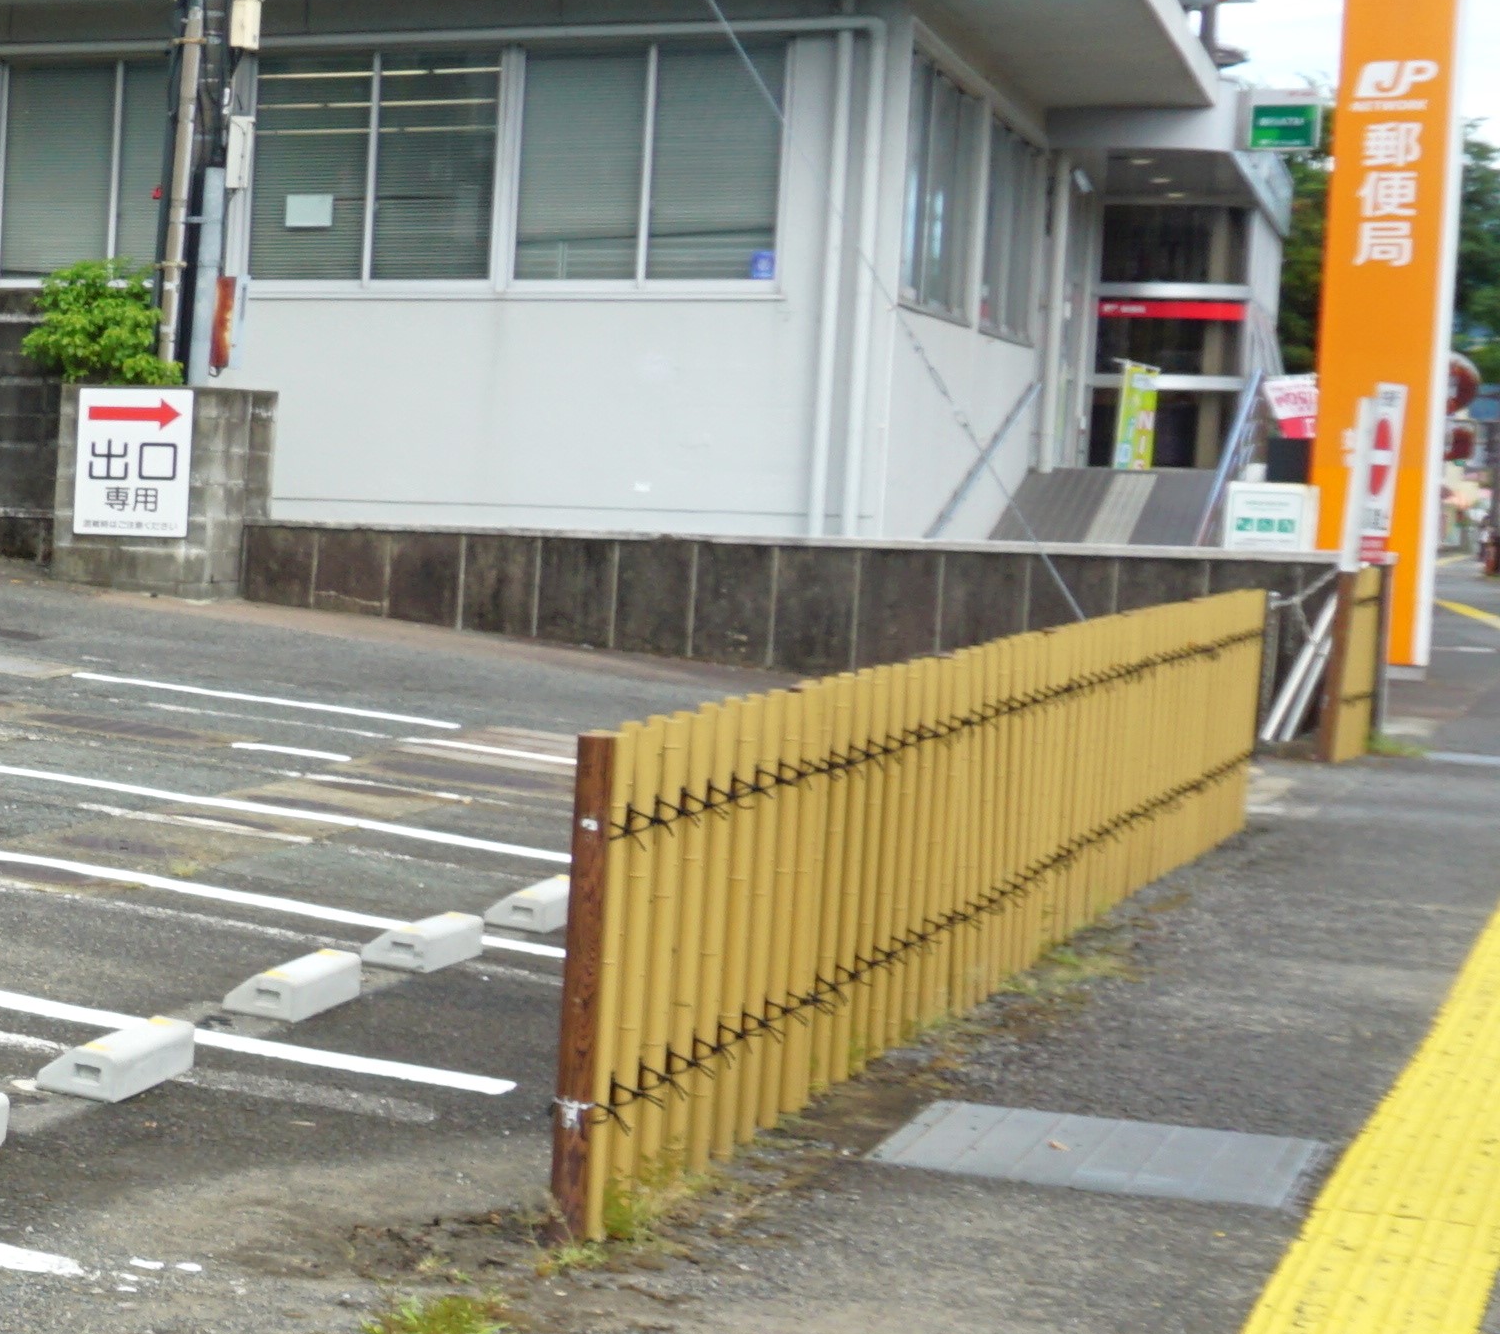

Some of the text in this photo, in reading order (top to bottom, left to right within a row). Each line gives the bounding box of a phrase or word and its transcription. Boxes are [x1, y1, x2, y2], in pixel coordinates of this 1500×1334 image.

[1353, 122, 1423, 267] 郵便局
[88, 438, 178, 481] 出口
[105, 486, 159, 512] 専用
